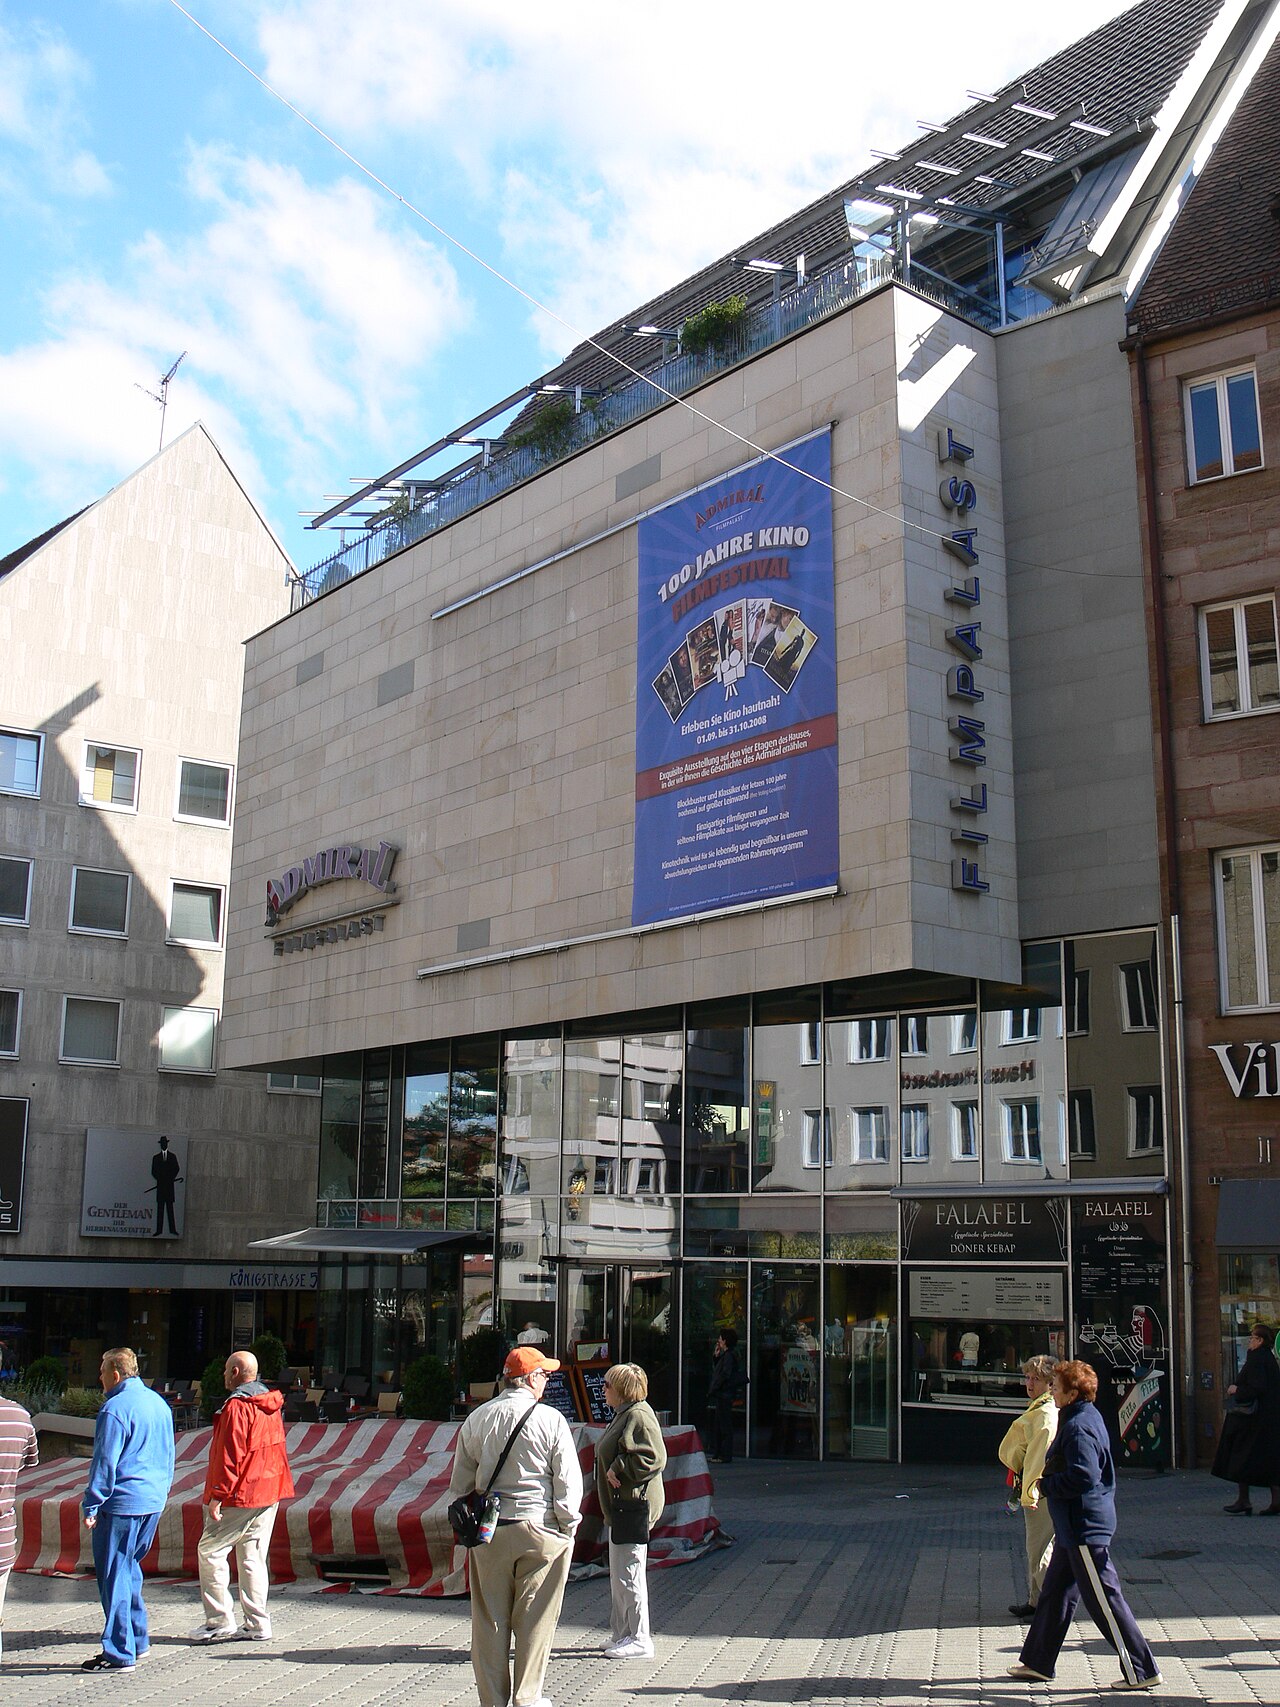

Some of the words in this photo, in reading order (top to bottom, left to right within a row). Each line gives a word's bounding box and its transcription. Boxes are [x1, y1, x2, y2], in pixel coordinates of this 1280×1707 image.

[696, 484, 765, 533] ADMIRAL
[716, 515, 743, 530] FILMPALAST
[657, 564, 691, 603] 100
[695, 532, 753, 580] JAHRE
[759, 526, 810, 548] KINO
[672, 557, 791, 623] FILMFESTIVAL
[942, 428, 989, 892] FILMPALAST
[681, 720, 710, 735] Erleben
[711, 714, 722, 727] Sie
[723, 709, 741, 722] Kino
[742, 695, 780, 716] hautnah!
[697, 732, 717, 744] 01.09.
[718, 727, 728, 738] bis
[729, 715, 767, 735] 31.10.2008
[659, 766, 683, 780] Exquisite
[684, 756, 719, 772] Ausstellung
[720, 751, 729, 761] auf
[730, 749, 740, 759] den
[741, 745, 753, 755] vier
[754, 740, 777, 754] Etagen
[778, 736, 787, 745] des
[661, 781, 667, 789] in
[675, 775, 684, 784] wir
[684, 772, 700, 782] Ihnen
[701, 768, 709, 777] die
[710, 759, 742, 774] Geschichte
[743, 755, 754, 765] des
[755, 745, 781, 761] Admiral
[676, 795, 706, 808] Blockbuster
[707, 790, 717, 800] und
[718, 785, 740, 797] Klassiker
[766, 776, 774, 784] 100
[678, 806, 697, 817] nochmal
[724, 791, 749, 806] Leinwand
[677, 835, 695, 845] seltene
[696, 827, 726, 841] Filmplakate
[779, 811, 790, 820] Zeit
[696, 818, 726, 831] Einzigartige
[726, 810, 757, 824] Filmfiguren
[758, 806, 768, 815] und
[661, 855, 690, 869] Kinotechnik
[690, 853, 700, 862] wird
[716, 844, 739, 857] lebendig
[739, 840, 750, 850] und
[751, 835, 780, 848] begreifbar
[780, 833, 786, 841] in
[786, 829, 808, 840] unserem
[708, 860, 717, 869] und
[717, 852, 750, 868] spannenden
[750, 841, 804, 859] Rahmenprogramm
[265, 840, 397, 927] ADMIRAL
[87, 1206, 153, 1219] GENTLEMAN
[936, 1203, 1032, 1225] FALAFEL
[1085, 1201, 1153, 1216] FALAFEL
[987, 1243, 1016, 1253] KEBAP
[229, 1268, 306, 1287] KÖNIGSTRASSE
[310, 1272, 318, 1288] 5
